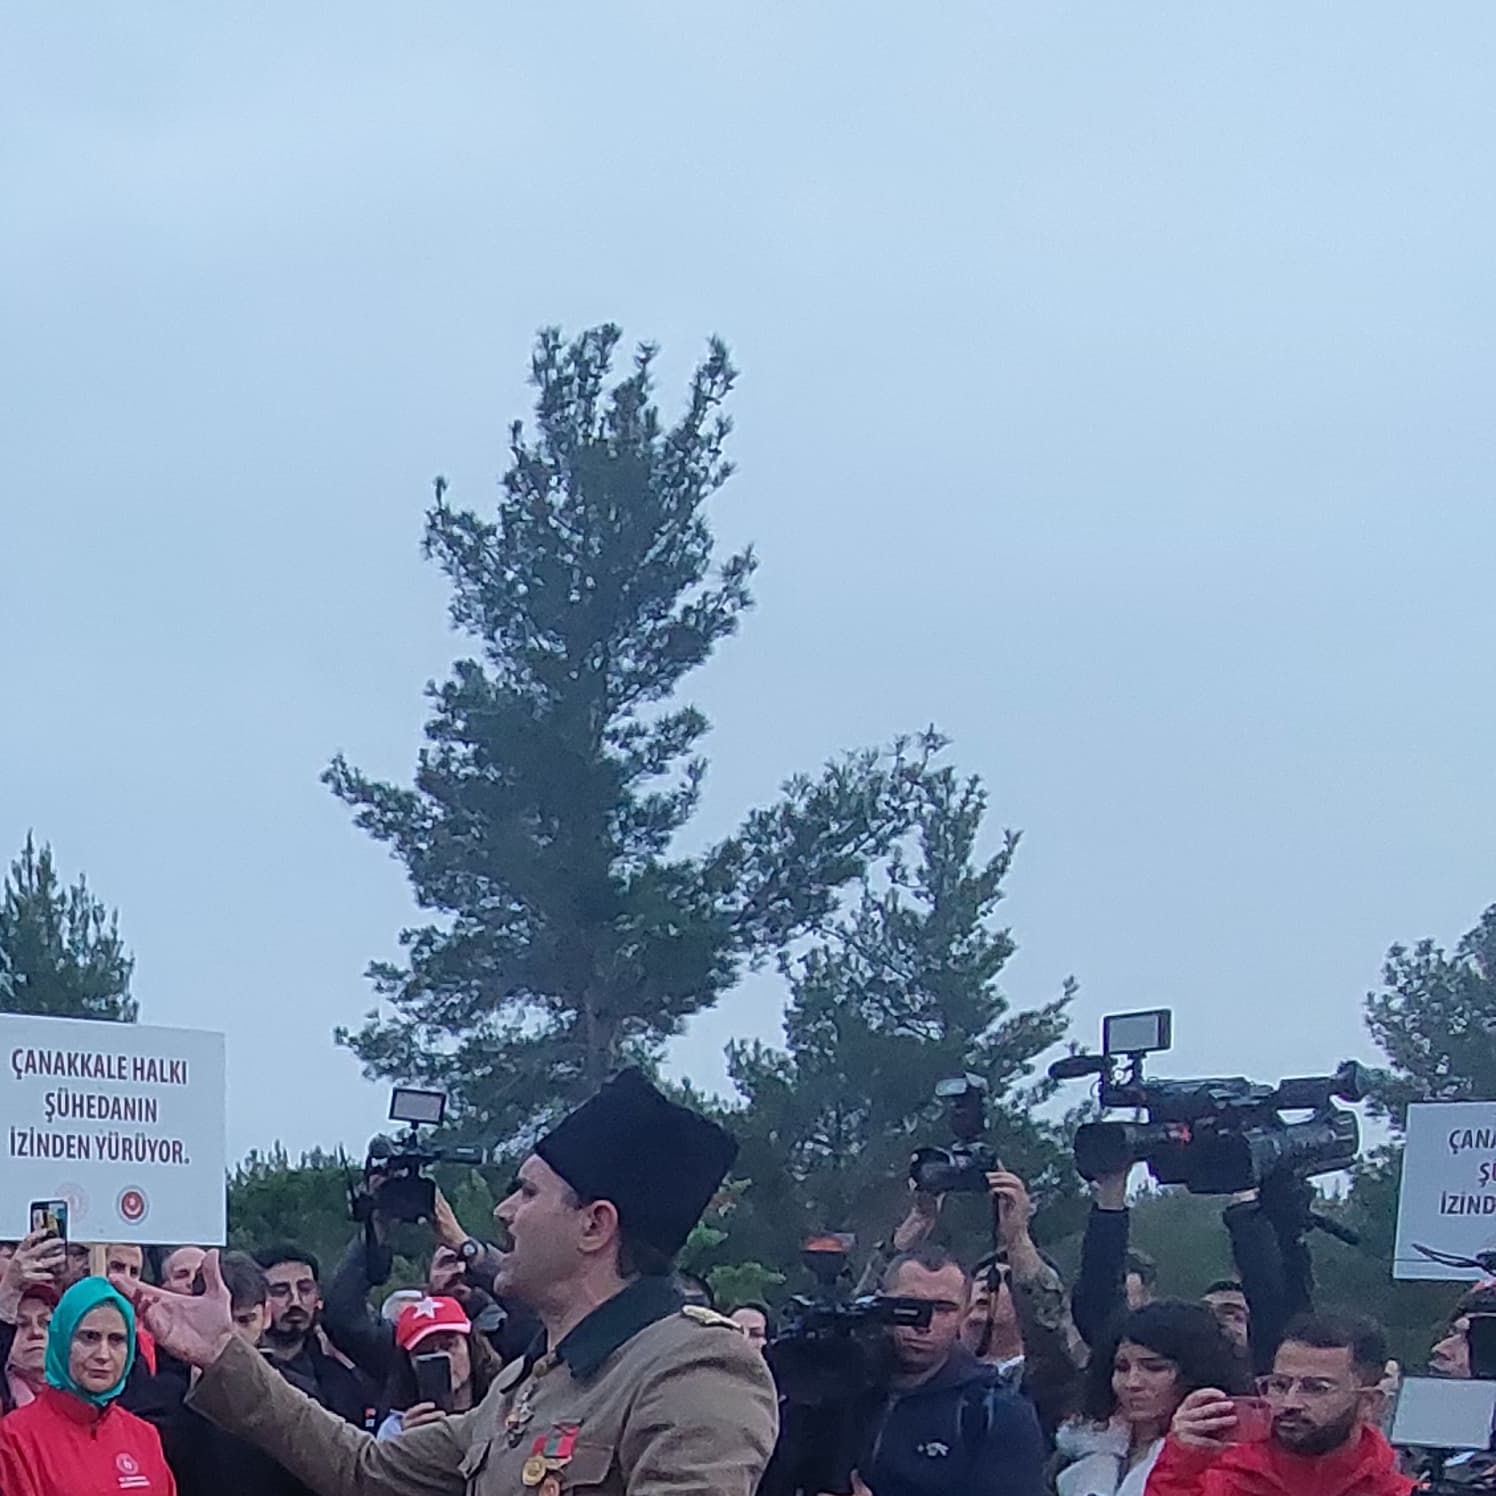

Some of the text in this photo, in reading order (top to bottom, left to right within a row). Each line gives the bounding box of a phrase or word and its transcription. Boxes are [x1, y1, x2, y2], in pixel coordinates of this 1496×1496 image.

[11, 1049, 187, 1086] ÇANAKKALE HALKI
[45, 1087, 158, 1124] ŞÜHEDANIN
[10, 1126, 191, 1165] İZİNDEN YÜRÜYOR.
